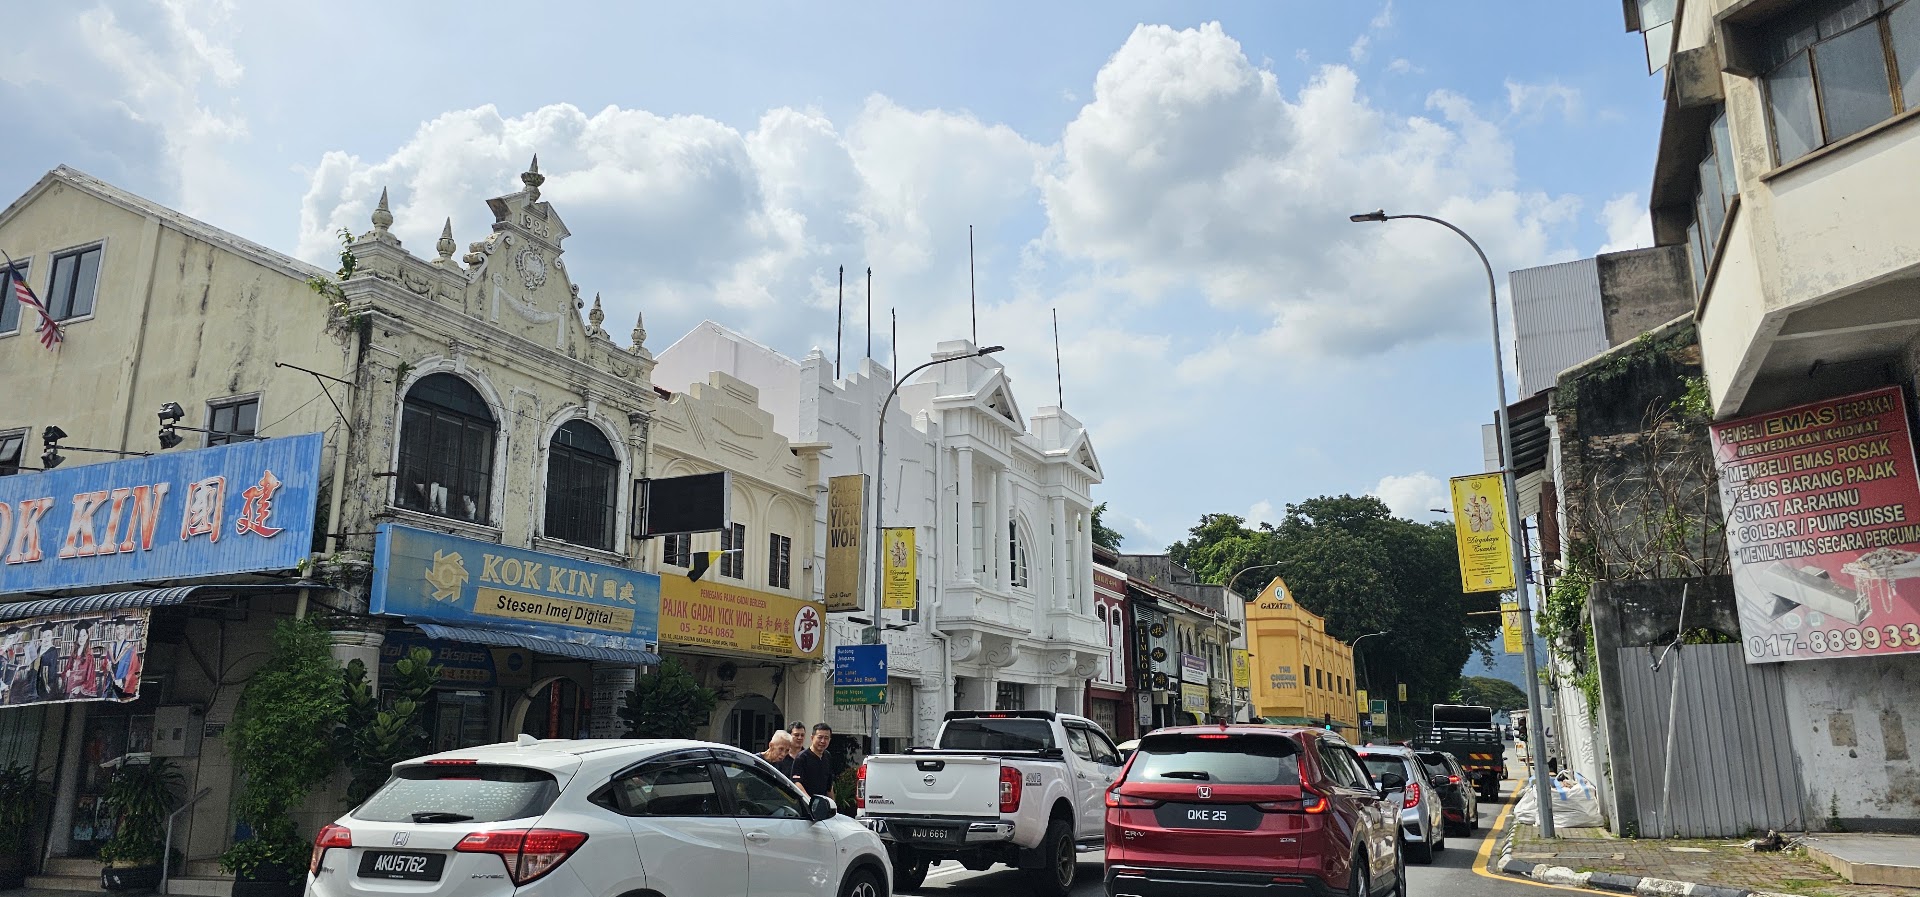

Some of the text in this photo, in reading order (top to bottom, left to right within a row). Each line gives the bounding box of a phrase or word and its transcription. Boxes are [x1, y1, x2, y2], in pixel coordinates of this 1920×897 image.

[520, 212, 550, 238] 1925
[1718, 394, 1895, 445] PEMBELI EMAS TERPAKAI
[1737, 420, 1880, 457] MENYEDIAKAN KHIDMAT
[1727, 438, 1892, 483] MEMBELI EMAS ROSAK
[1731, 460, 1898, 501] TEBUS BARANG PAJAK
[59, 482, 170, 560] KIN
[830, 507, 859, 527] YICK
[1734, 489, 1860, 524] SURAT AR-RAHNU
[831, 528, 857, 547] WOH
[1737, 520, 1798, 544] GOLBAR
[1807, 503, 1906, 536] PUMPSUISSE
[1741, 522, 1920, 564] MENILAI EMAS SECARA PERCUMA
[480, 553, 598, 599] KOK KIN
[496, 595, 614, 626] Stesen Imej Digital
[700, 588, 723, 601] PEMEGANG
[723, 592, 736, 604] PAJAK
[736, 595, 749, 606] GADAI
[662, 597, 753, 629] PAJAK GADAI YICK WOH
[680, 622, 691, 633] 05
[698, 624, 713, 636] 254
[716, 627, 735, 639] 0862
[1139, 628, 1148, 651] LIM
[438, 647, 486, 663] Ekspres
[1140, 655, 1149, 669] KO
[1187, 809, 1227, 821] QKE 25
[911, 829, 948, 839] AJU 6661
